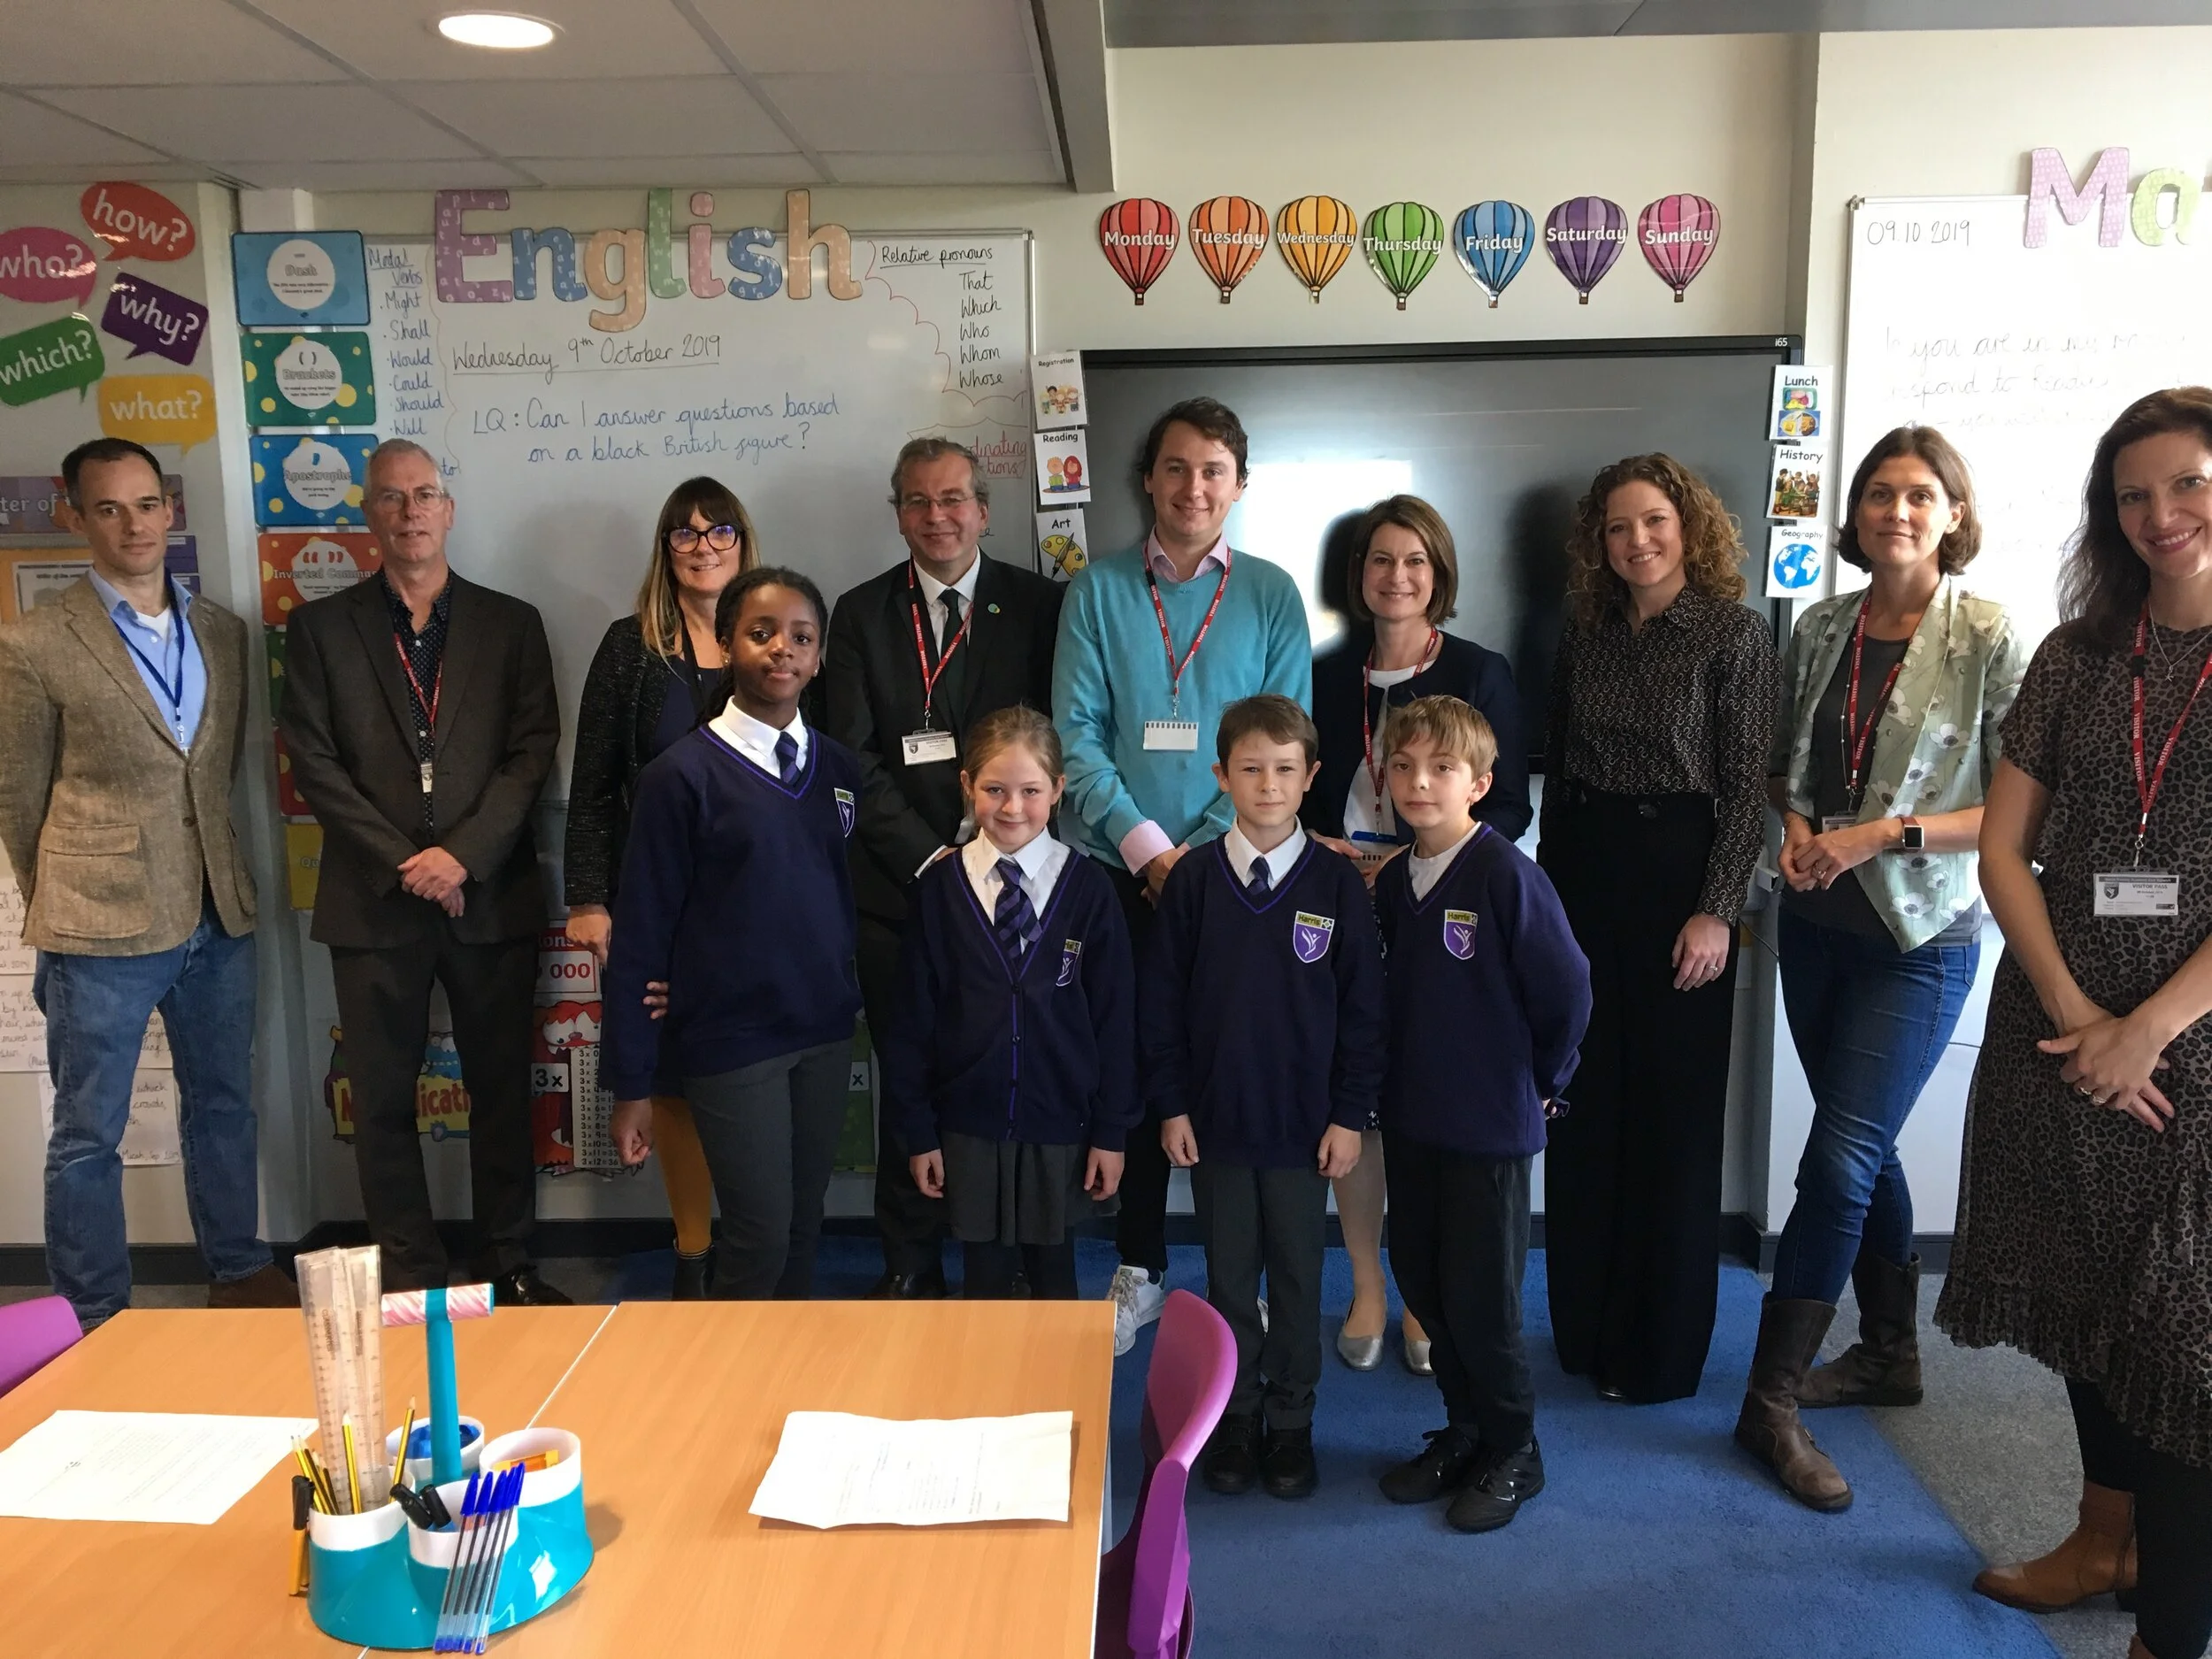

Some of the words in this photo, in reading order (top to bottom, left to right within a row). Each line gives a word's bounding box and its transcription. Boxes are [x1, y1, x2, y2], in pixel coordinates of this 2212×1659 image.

[93, 188, 188, 252] how?
[1104, 230, 1177, 251] Monday
[1192, 227, 1267, 250] Tuesday
[1277, 230, 1356, 249] Wednesday
[1546, 225, 1627, 245] Saturday
[1644, 226, 1715, 247] Sunday
[1867, 219, 1970, 247] 09.10.2019
[1363, 234, 1443, 256] Thursday
[1465, 233, 1525, 256] Friday
[0, 244, 83, 280] who?
[367, 247, 409, 268] Modal
[434, 187, 863, 333] English
[881, 245, 934, 264] Relative
[939, 248, 993, 269] pronouns
[285, 263, 319, 276] Dash
[391, 268, 423, 286] Verbs
[959, 270, 994, 291] That
[385, 291, 422, 319] Might
[961, 295, 1002, 319] Which
[119, 290, 200, 346] why?
[389, 319, 431, 341] Shall
[960, 321, 990, 342] Who
[1775, 338, 1788, 347] i65
[0, 330, 94, 386] which?
[390, 350, 434, 370] Would
[453, 342, 559, 384] Wednesday
[567, 336, 594, 363] 9th
[601, 337, 673, 364] October
[682, 334, 721, 357] 2019
[960, 343, 1002, 365] Whom
[1038, 357, 1074, 367] Registration
[1909, 338, 1961, 378] you
[1972, 333, 2012, 357] are
[282, 367, 336, 380] Brackets
[959, 369, 1004, 389] Whose
[1785, 375, 1818, 387] Lunch
[392, 375, 434, 394] Could
[110, 389, 203, 420] what?
[394, 396, 445, 414] Should
[526, 397, 569, 429] Can
[581, 401, 586, 427] I
[594, 409, 666, 428] answer
[675, 404, 773, 441] questions
[782, 391, 841, 416] based
[395, 419, 428, 437] Will
[1042, 433, 1079, 443] Reading
[527, 447, 555, 463] on
[565, 447, 583, 461] a
[592, 435, 649, 461] black
[664, 434, 727, 457] British
[1780, 449, 1824, 464] History
[37, 493, 59, 517] of
[1051, 518, 1071, 529] Art
[1781, 528, 1824, 540] Geography
[273, 567, 324, 580] Inverted
[2157, 736, 2175, 766] VISITOR
[2134, 751, 2143, 782] VISITOR
[1298, 913, 1321, 927] Harris
[1447, 911, 1471, 923] Harris
